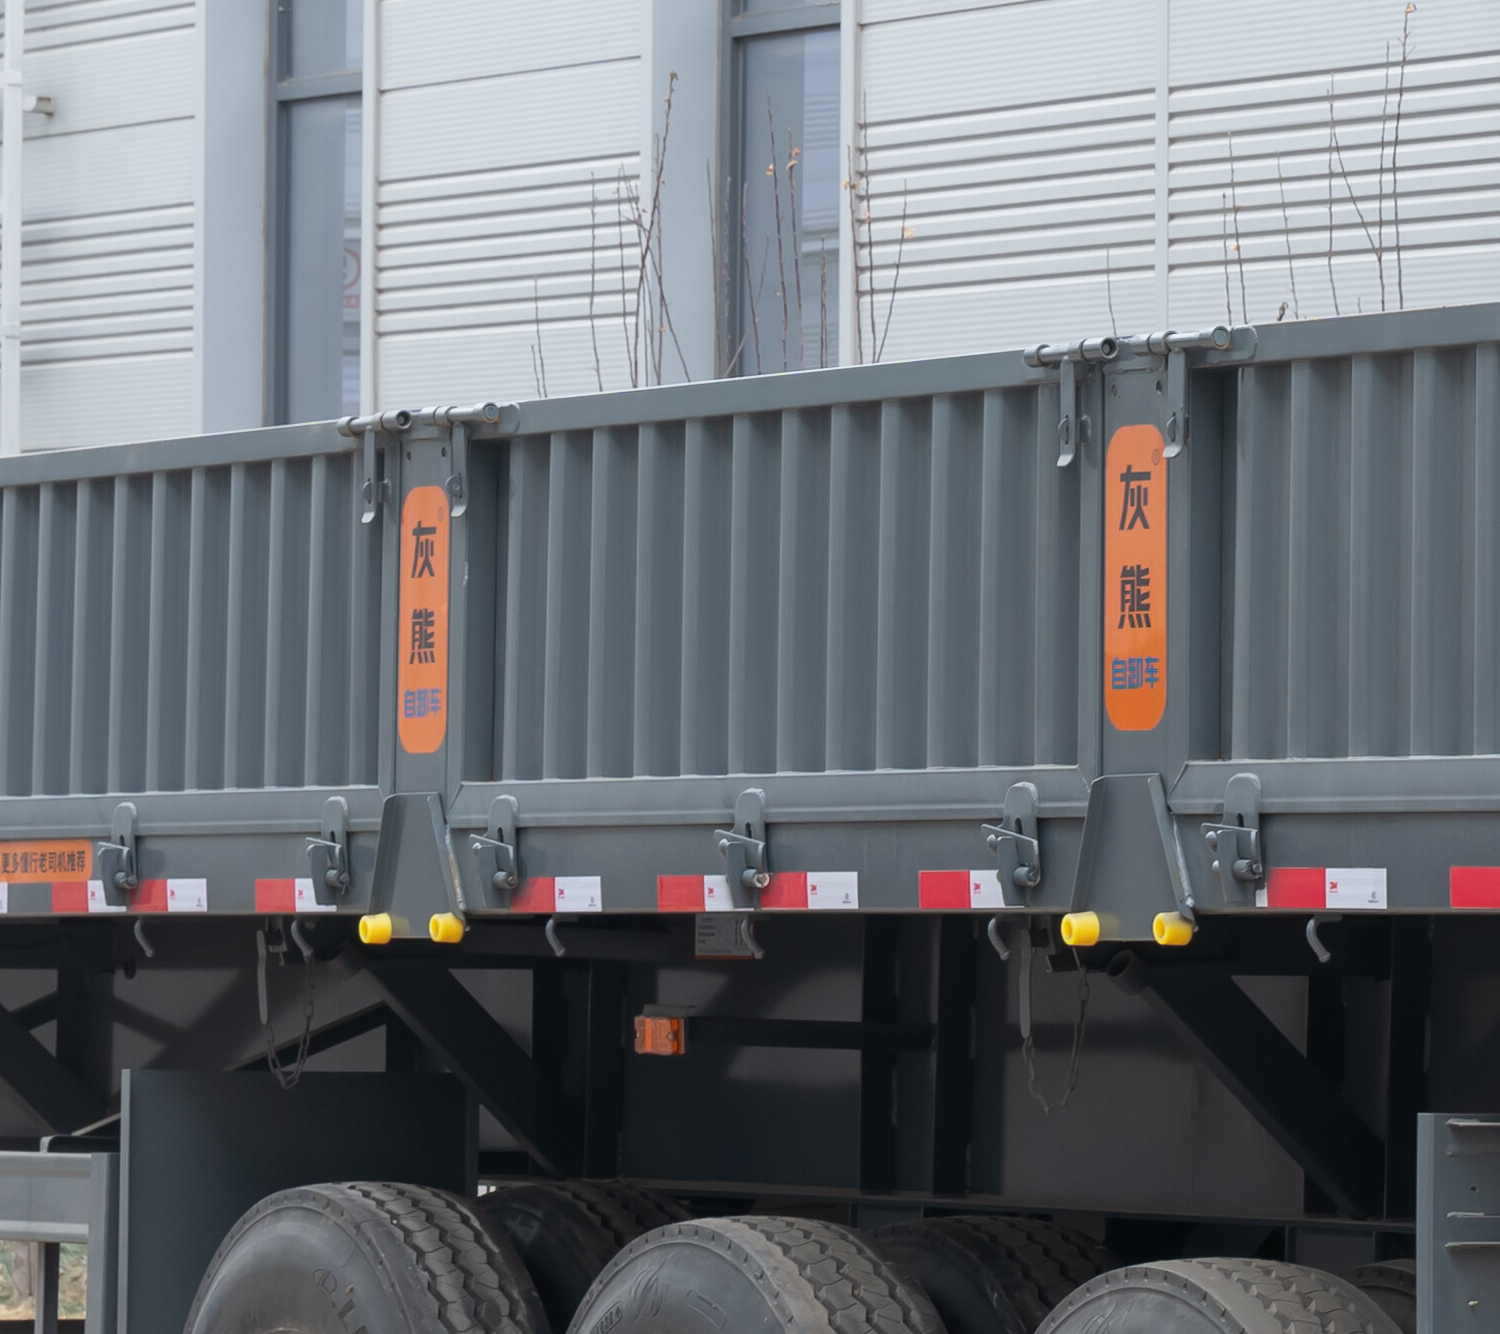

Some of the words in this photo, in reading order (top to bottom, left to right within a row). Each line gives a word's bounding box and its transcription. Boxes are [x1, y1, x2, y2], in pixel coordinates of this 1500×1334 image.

[410, 521, 437, 665] 灰熊
[1118, 464, 1152, 630] 灰熊
[1111, 656, 1160, 690] 自卸车
